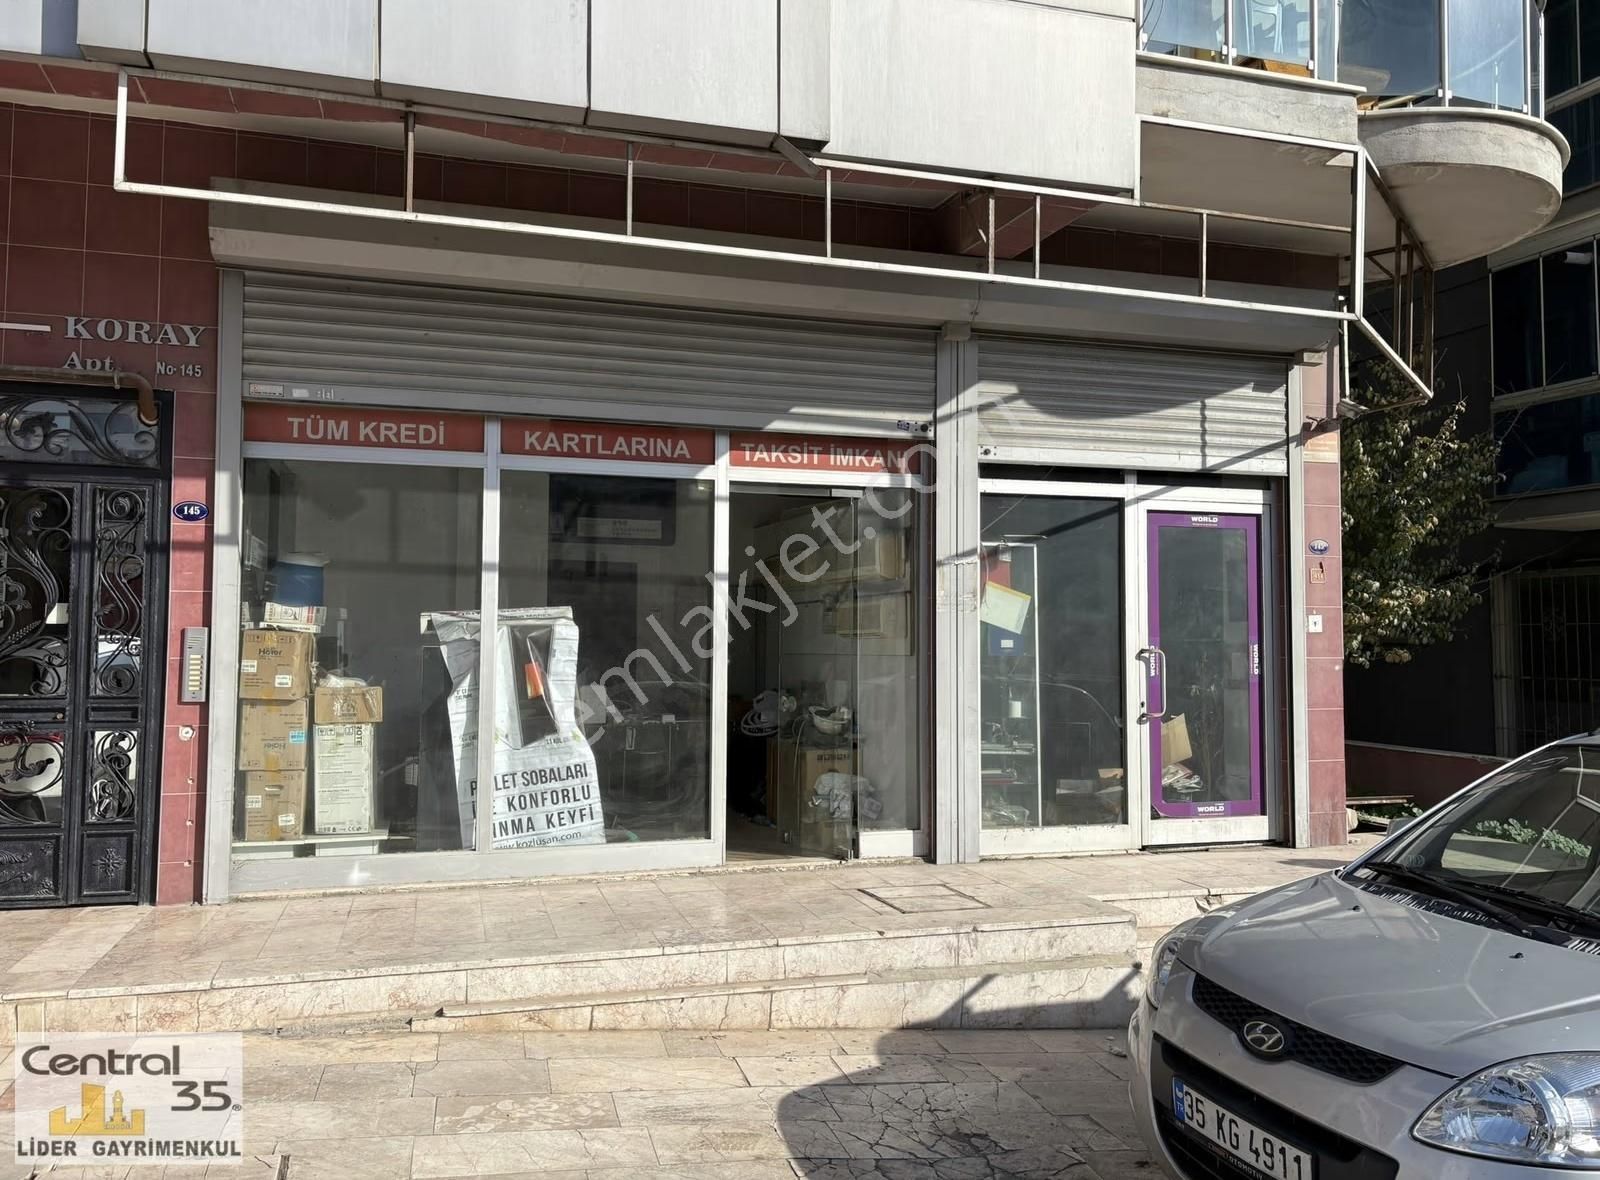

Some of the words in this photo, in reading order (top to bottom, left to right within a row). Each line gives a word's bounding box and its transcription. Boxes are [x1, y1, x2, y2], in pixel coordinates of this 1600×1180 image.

[64, 316, 206, 347] KORAY
[180, 363, 202, 377] 145
[288, 414, 348, 441] TÜM
[359, 421, 445, 445] KREDİ
[524, 430, 691, 458] KARTLARINA
[741, 442, 824, 464] TAKSİT
[184, 506, 200, 515] 145
[470, 772, 517, 796] PLET
[521, 763, 588, 787] SOBALARI
[507, 785, 591, 812] KONFORLU
[493, 816, 535, 838] INMA
[546, 804, 594, 829] KEYFİ
[1185, 1091, 1205, 1129] 35
[1216, 1109, 1240, 1151] KG
[1249, 1129, 1302, 1180] 4911
